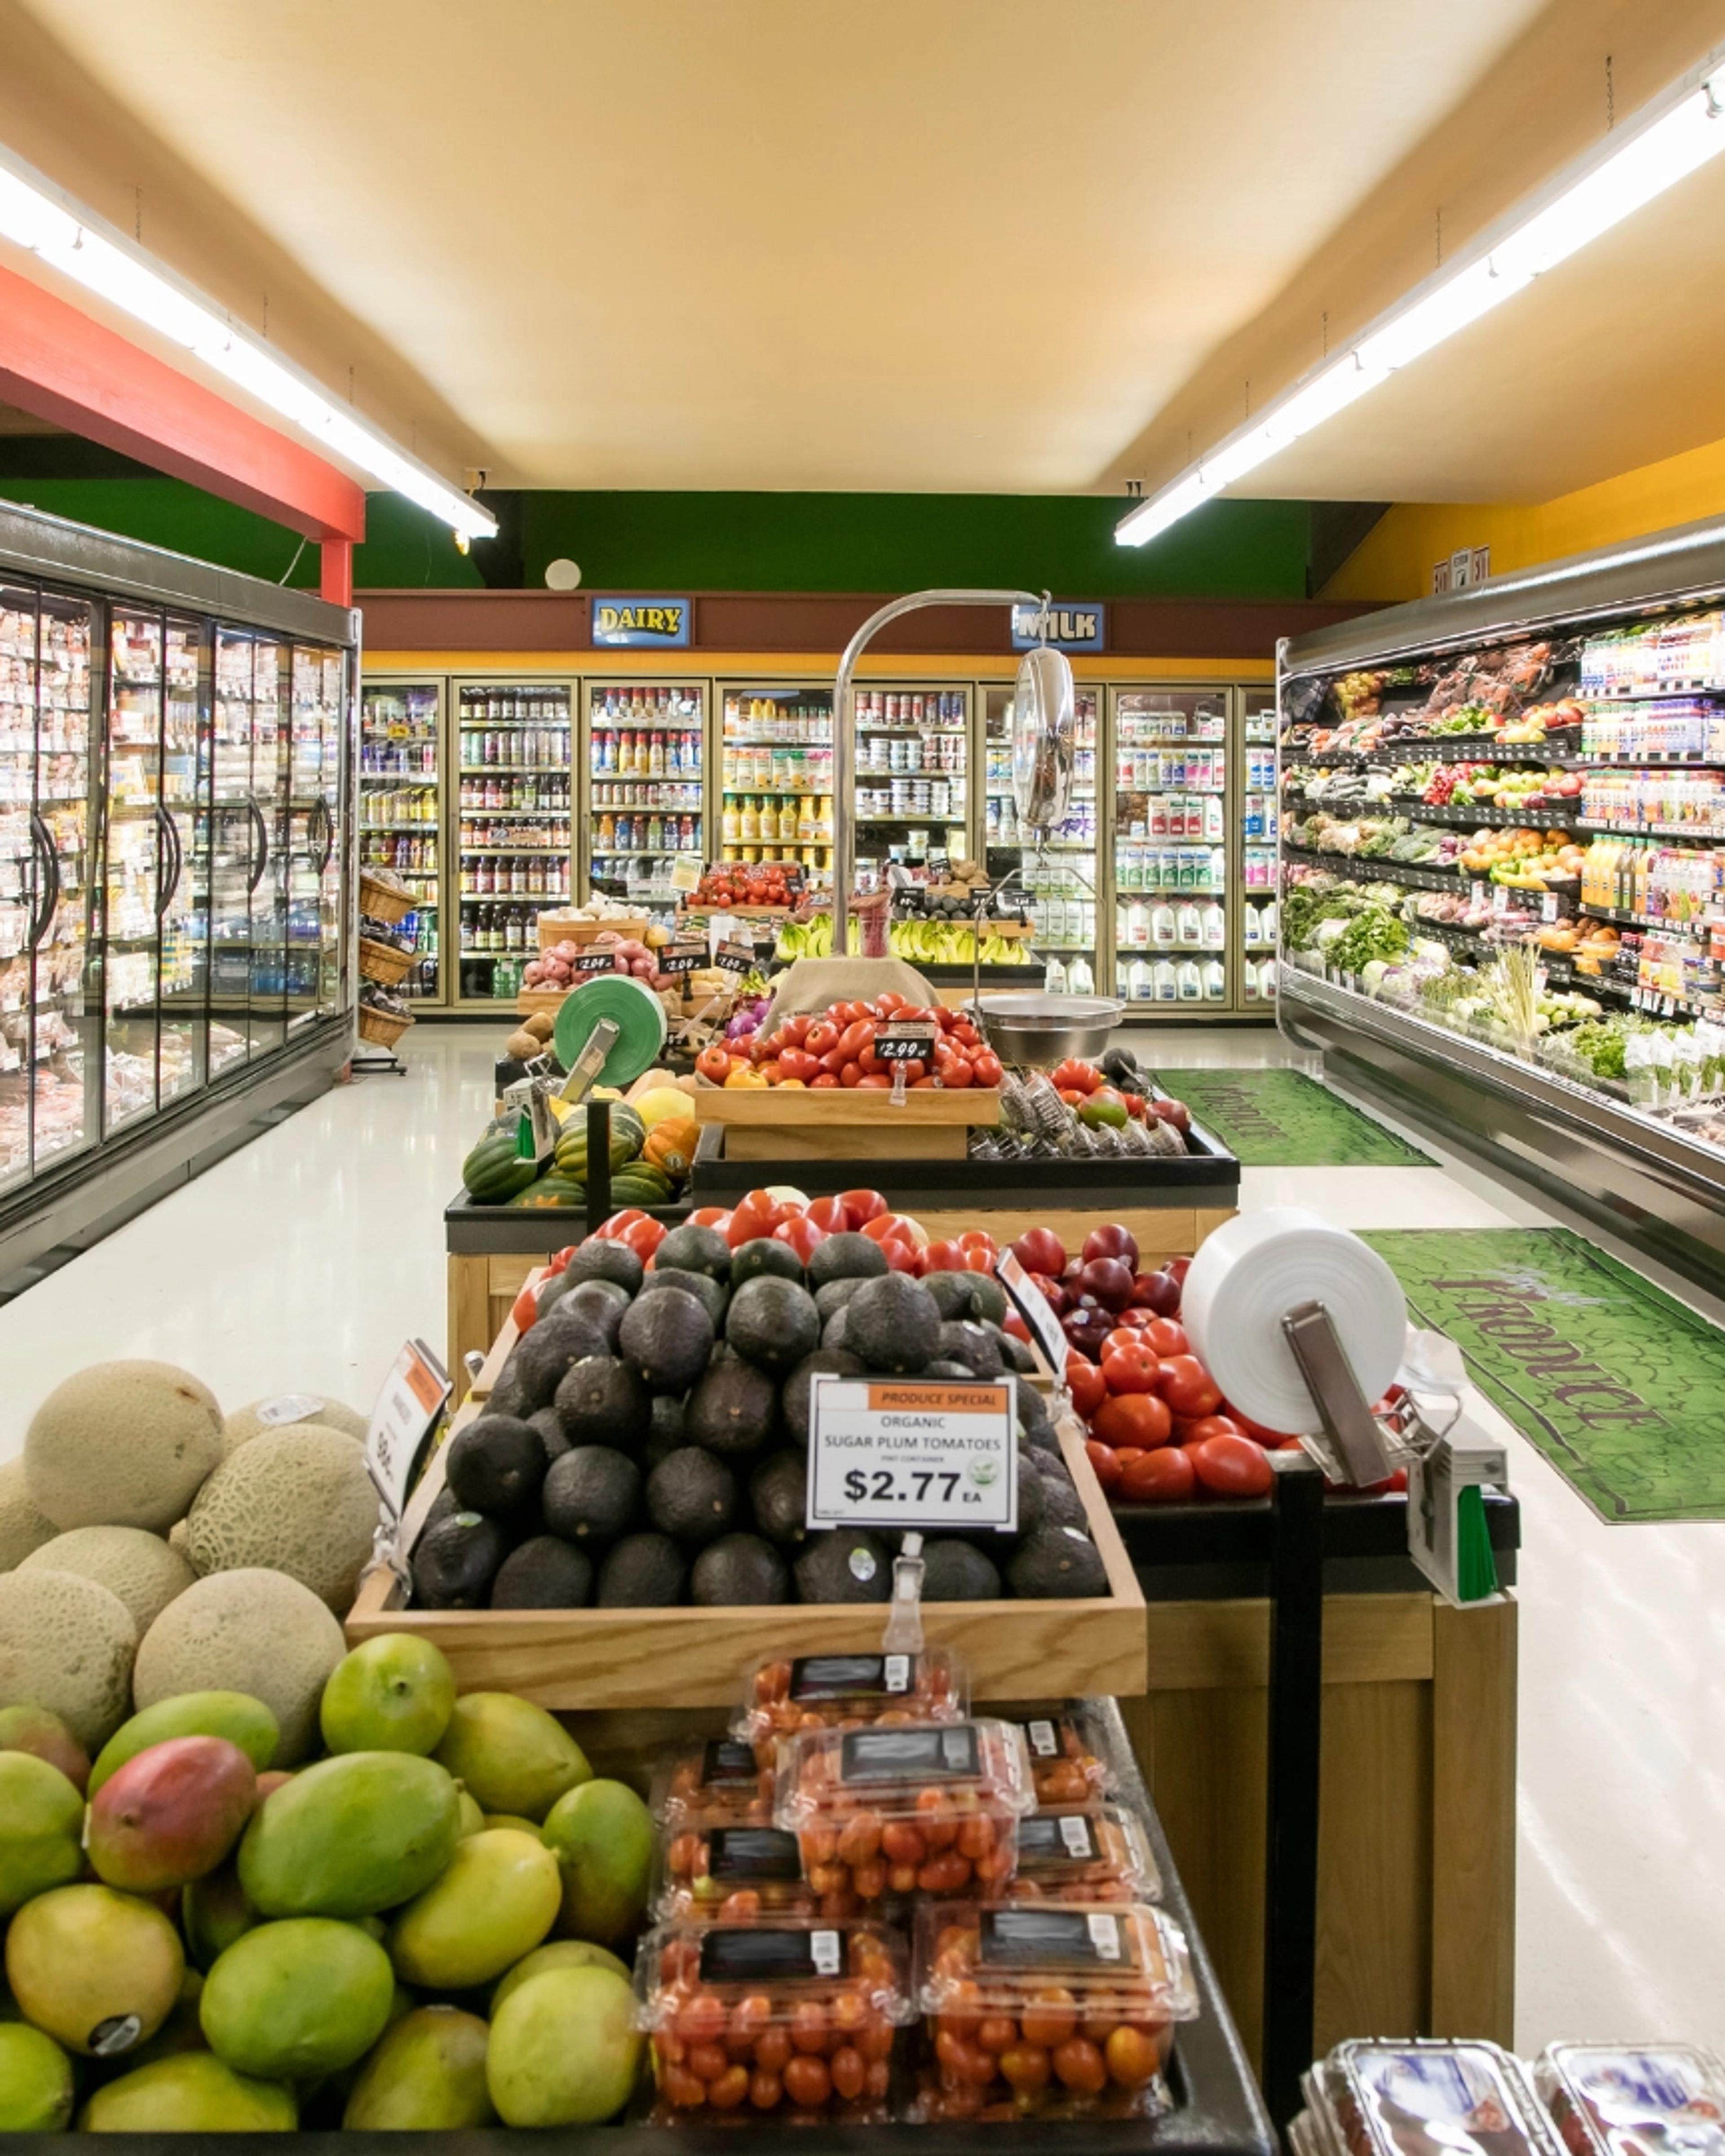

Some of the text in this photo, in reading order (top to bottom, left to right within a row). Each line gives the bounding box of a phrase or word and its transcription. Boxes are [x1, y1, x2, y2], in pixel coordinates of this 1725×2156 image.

[600, 607, 682, 632] DAIRY
[1018, 611, 1097, 640] MILK
[1430, 1279, 1675, 1431] PRODUCE
[881, 1392, 996, 1406] PRODUCE SPECIAL
[881, 1416, 945, 1429] ORGANIC
[825, 1436, 1001, 1451] SUGAR PLUM TOMATOES
[844, 1468, 961, 1503] $2.77
[963, 1493, 982, 1503] EA
